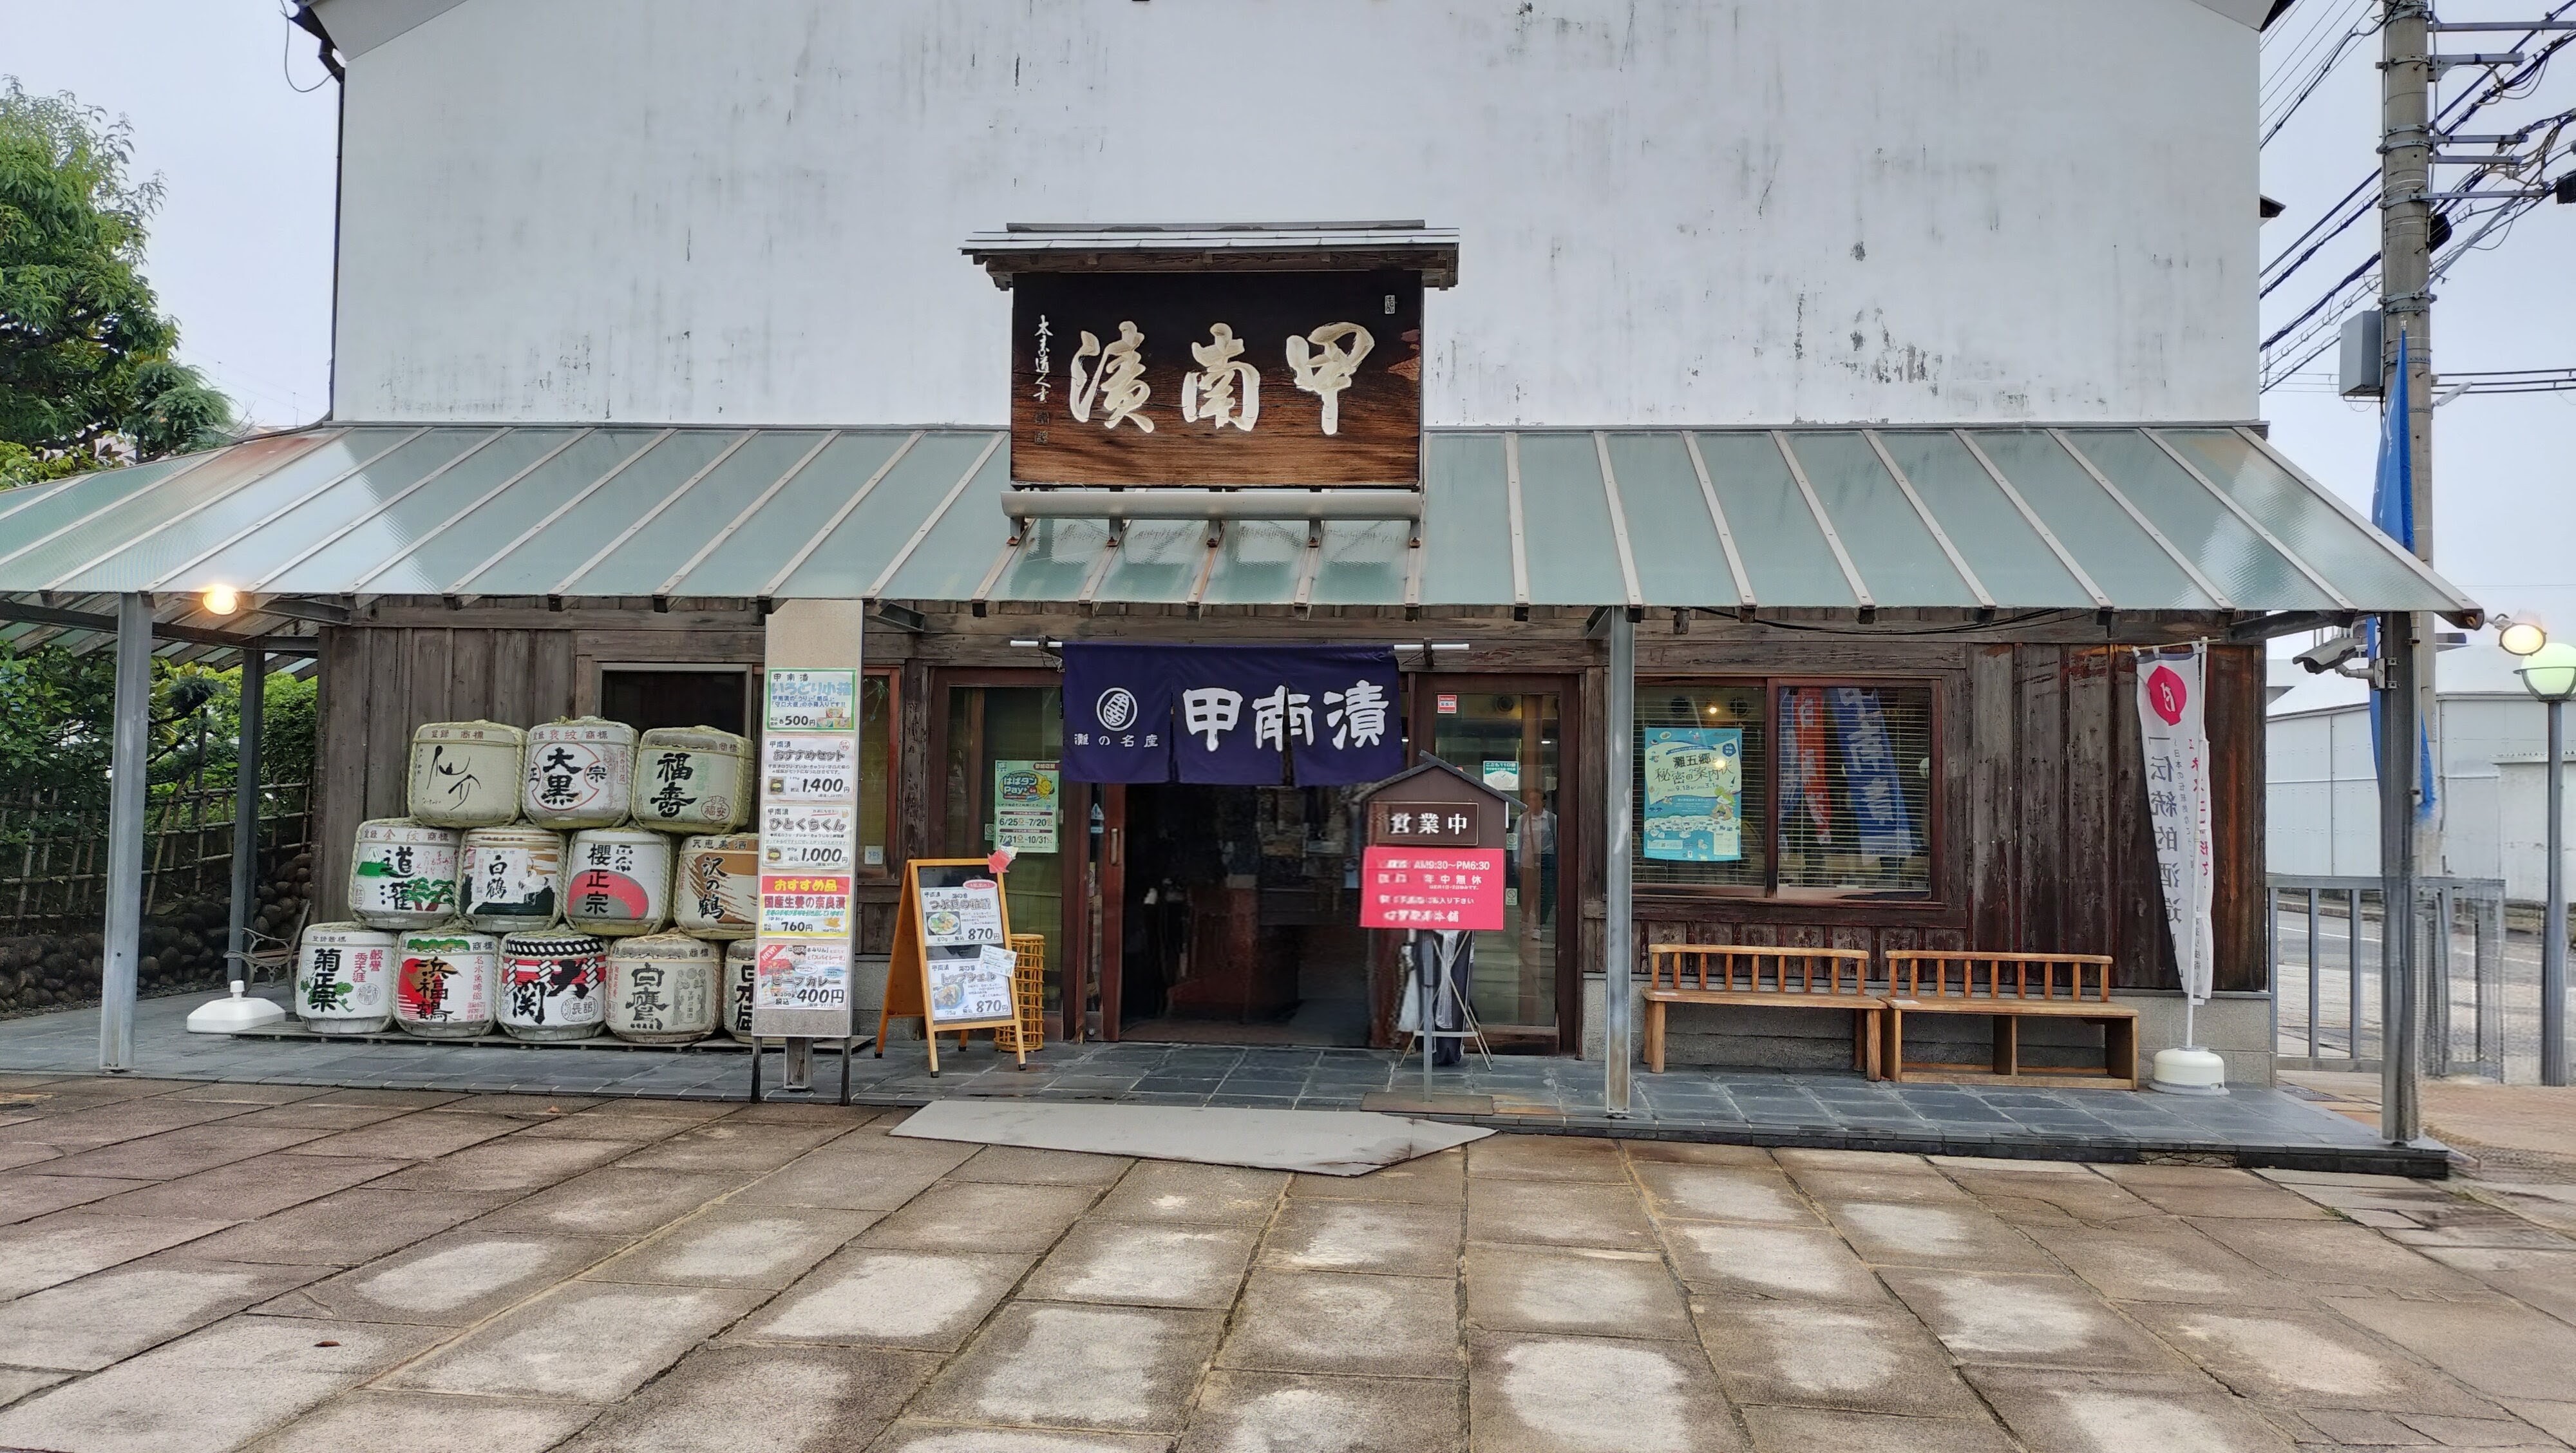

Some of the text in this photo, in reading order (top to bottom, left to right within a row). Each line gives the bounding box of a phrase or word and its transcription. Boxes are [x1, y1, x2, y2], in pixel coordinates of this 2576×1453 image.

[1069, 320, 1374, 435] 甲南漬
[773, 672, 808, 682] 甲南漬
[772, 682, 852, 696] いろどり小箱
[1182, 679, 1389, 752] 甲南漬
[1074, 733, 1159, 748] 灘の名産
[773, 749, 845, 762] おすすめセット
[541, 747, 584, 806] 大黒
[1004, 777, 1037, 785] はばタン
[802, 778, 850, 793] 1,400円
[769, 817, 846, 832] ひとくちくん
[1390, 813, 1468, 835] 営業中
[801, 848, 848, 863] 1,000円
[486, 855, 507, 900] 白鶴
[1423, 874, 1482, 884] 年中無休
[697, 857, 728, 920] 沢の鶴
[774, 878, 837, 892] おすすめ品
[764, 895, 846, 909] 国産生姜の奈良漬
[781, 922, 813, 932] 760円
[968, 927, 999, 940] 870円
[311, 947, 343, 1012] 菊正宗
[772, 975, 840, 987] ビーフカレー
[797, 989, 844, 1003] 400円
[976, 1000, 1010, 1012] 870円
